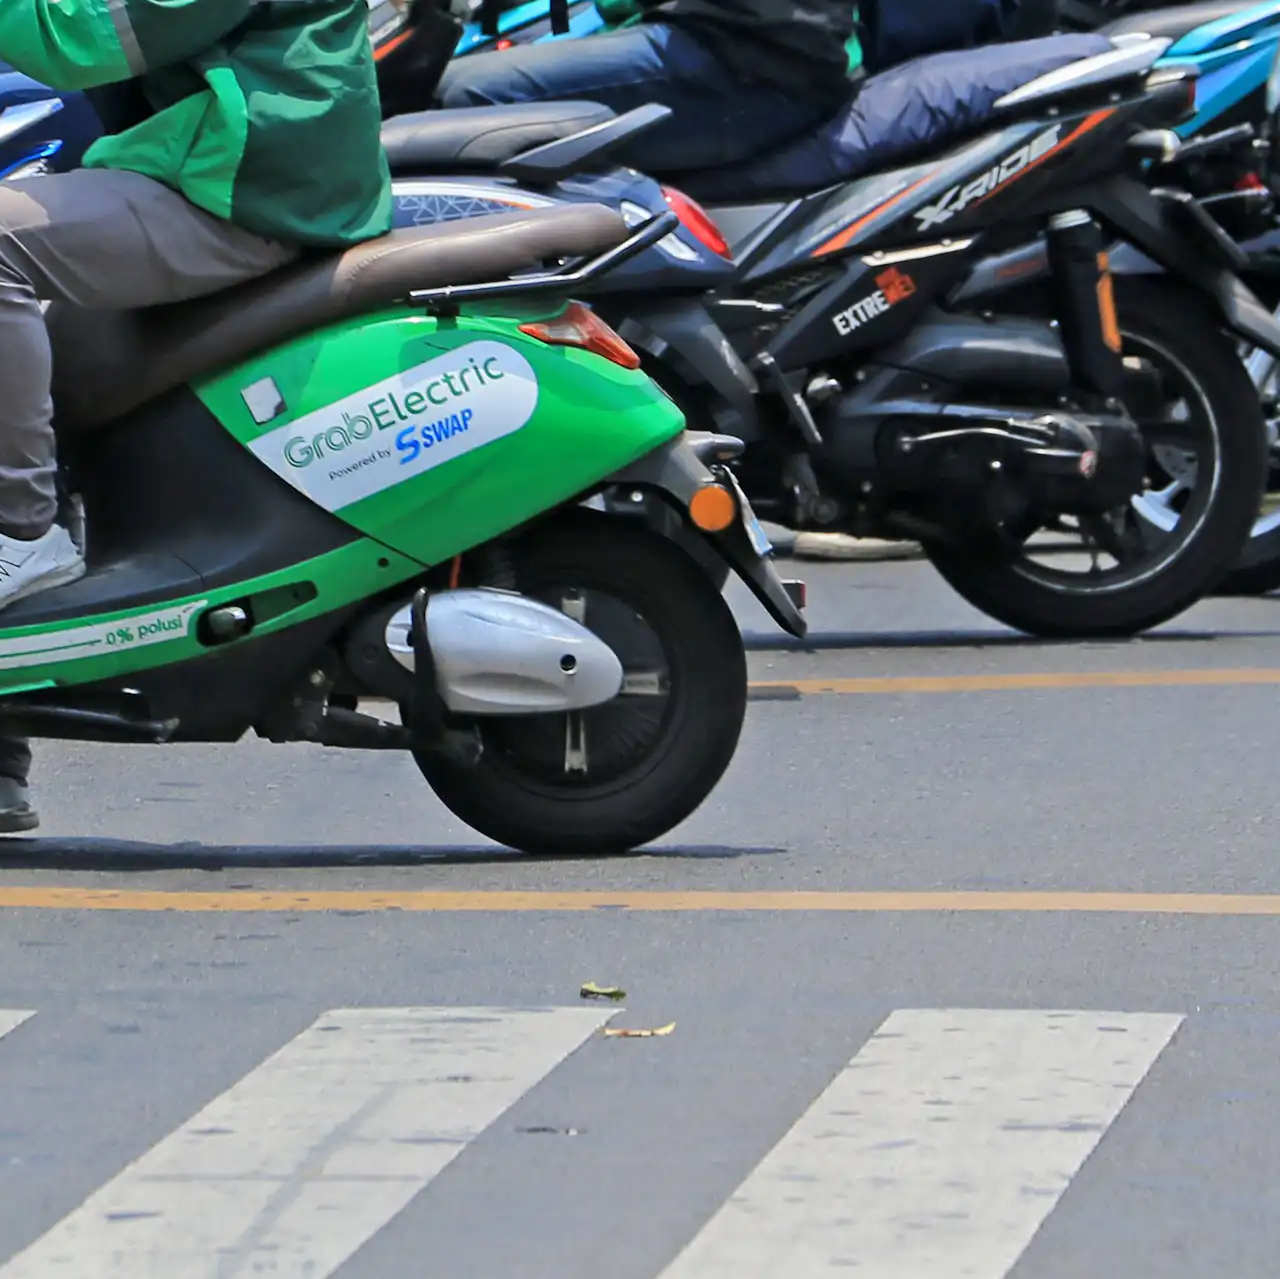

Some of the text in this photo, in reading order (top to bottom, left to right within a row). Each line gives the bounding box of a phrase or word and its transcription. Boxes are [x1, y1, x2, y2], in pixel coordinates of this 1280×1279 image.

[283, 356, 505, 469] GrabElectric
[376, 446, 392, 465] by
[105, 614, 184, 646] 0% polusi
